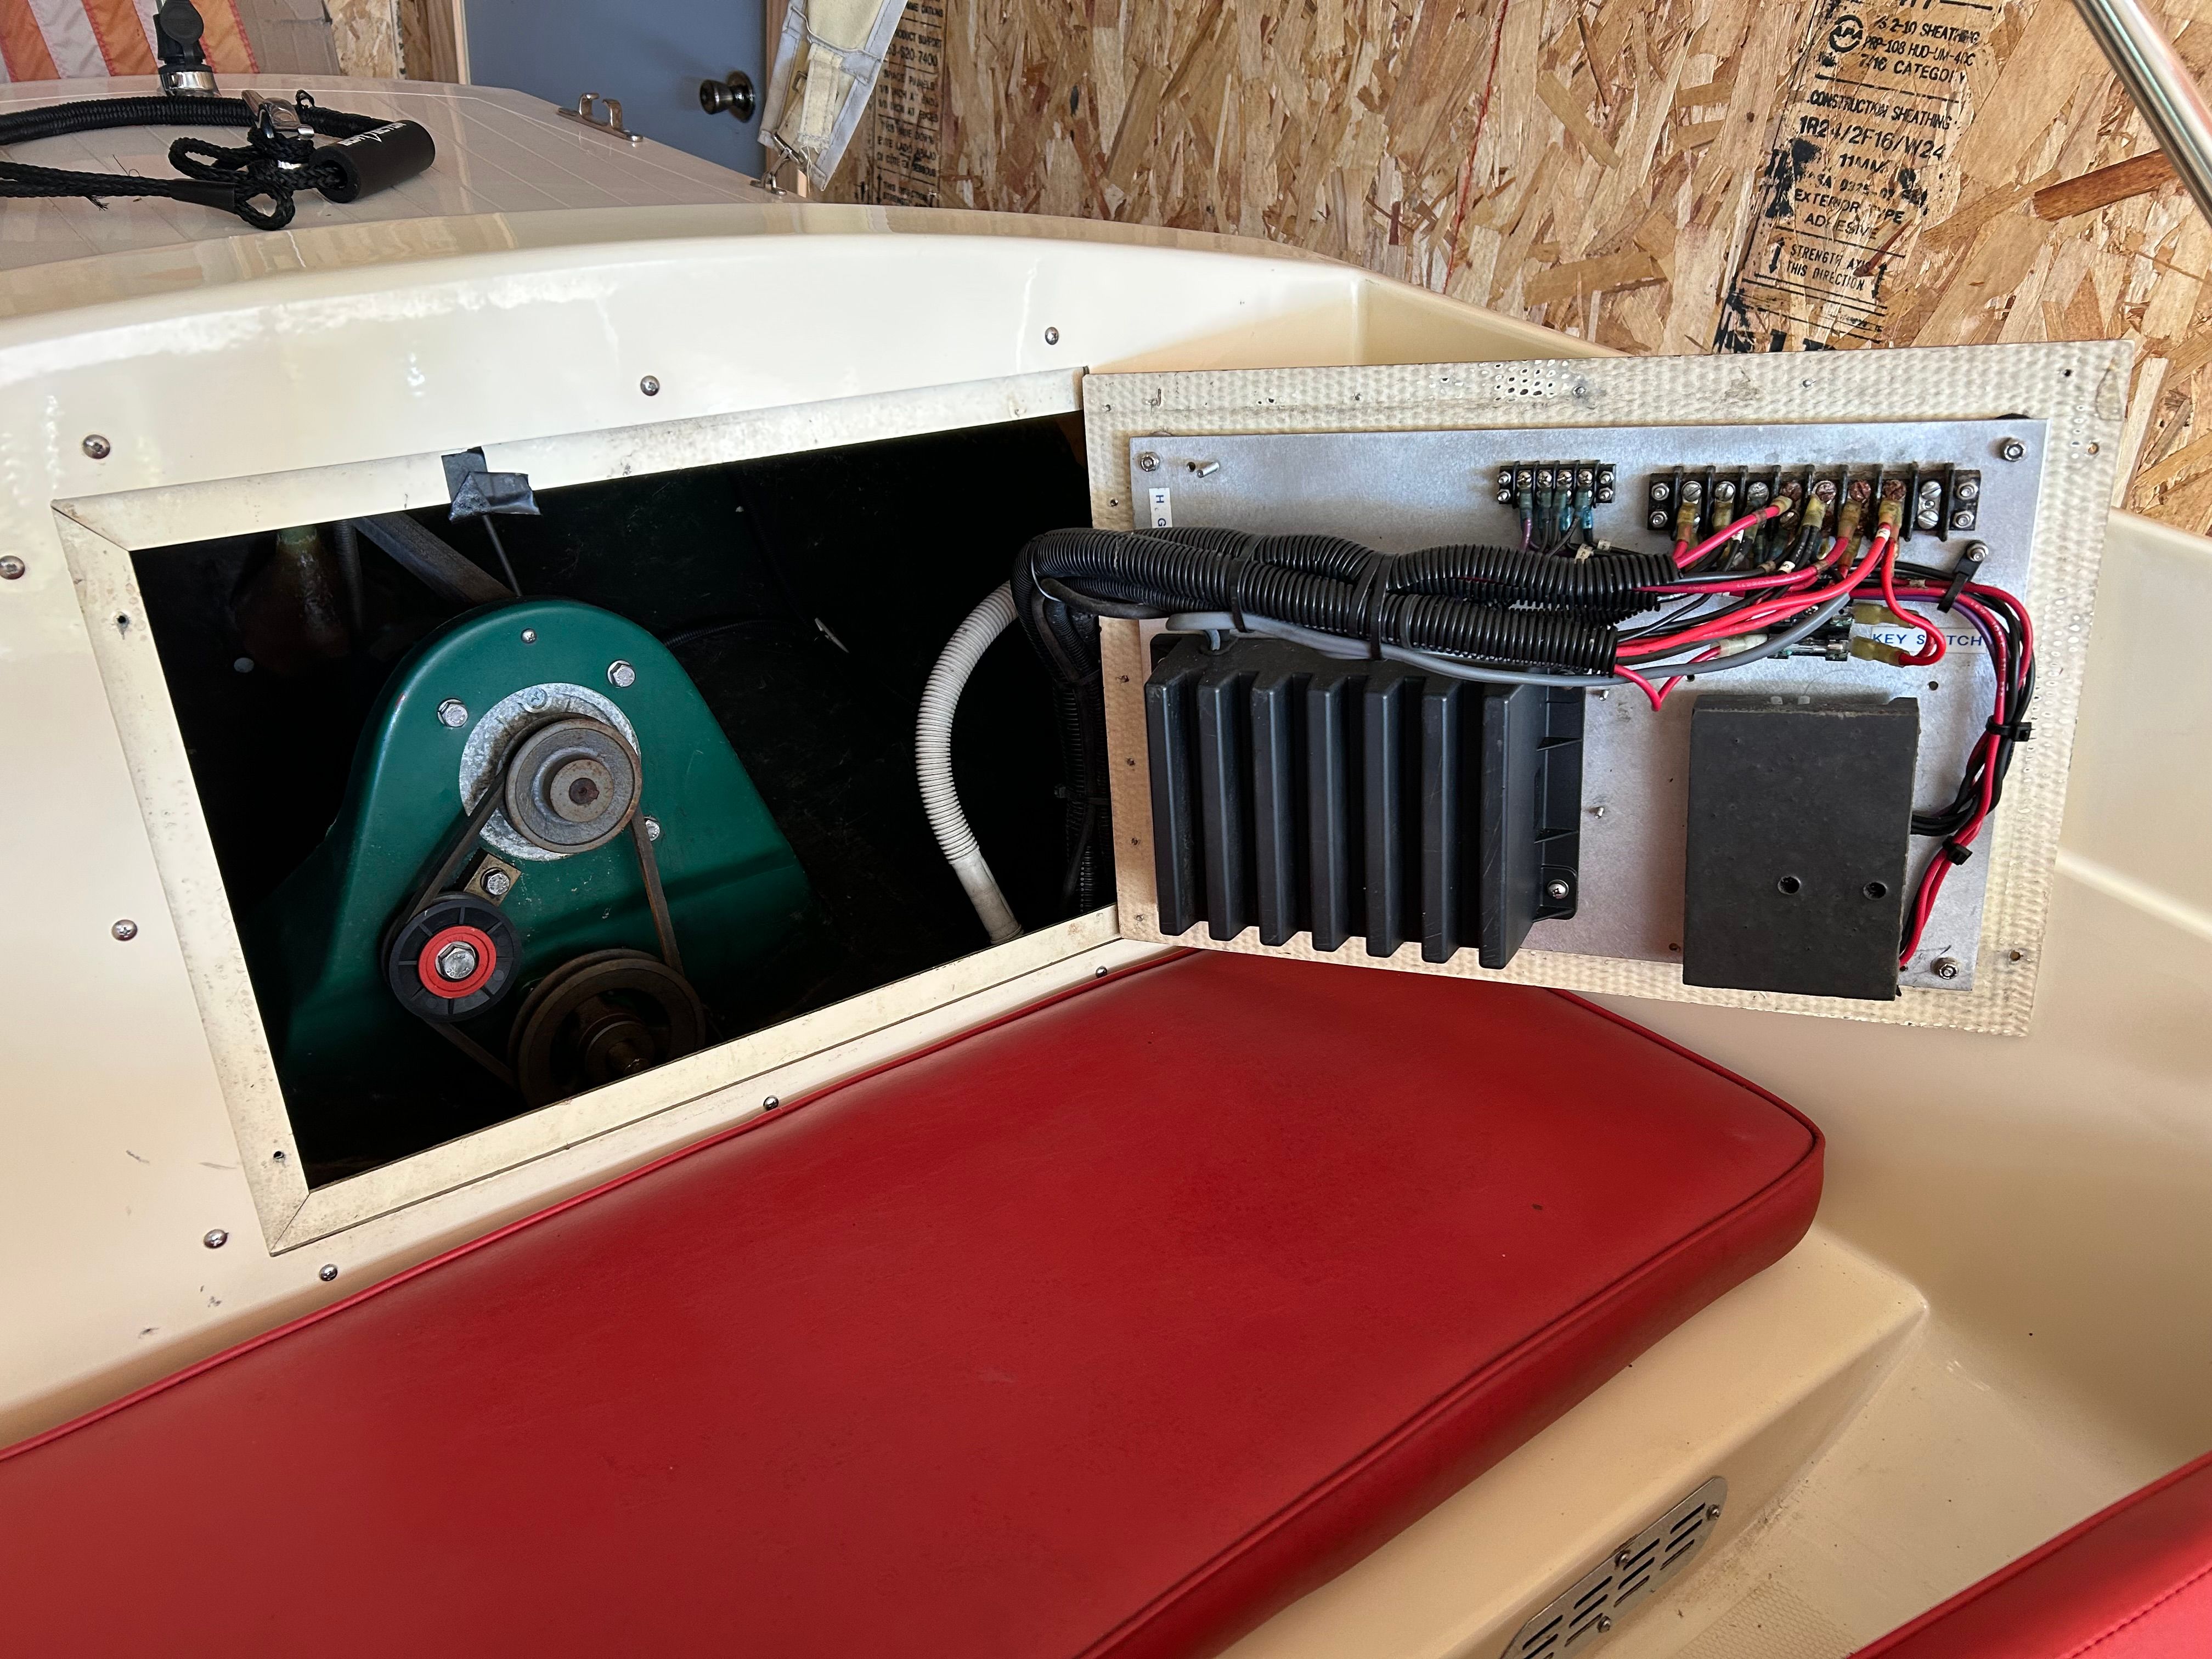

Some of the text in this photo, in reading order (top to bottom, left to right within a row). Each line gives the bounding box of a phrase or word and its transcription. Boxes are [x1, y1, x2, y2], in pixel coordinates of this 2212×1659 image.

[1894, 60, 1965, 83] CATEGOY
[1891, 105, 1952, 129] SHEATHING
[1869, 204, 1905, 224] YPE
[1804, 213, 1876, 240] ADESIVE
[1790, 243, 1842, 267] STRENGTH
[1787, 259, 1866, 291] THIS DIRECTION
[1872, 633, 1907, 645] KEY
[1917, 634, 1983, 646] STCH
